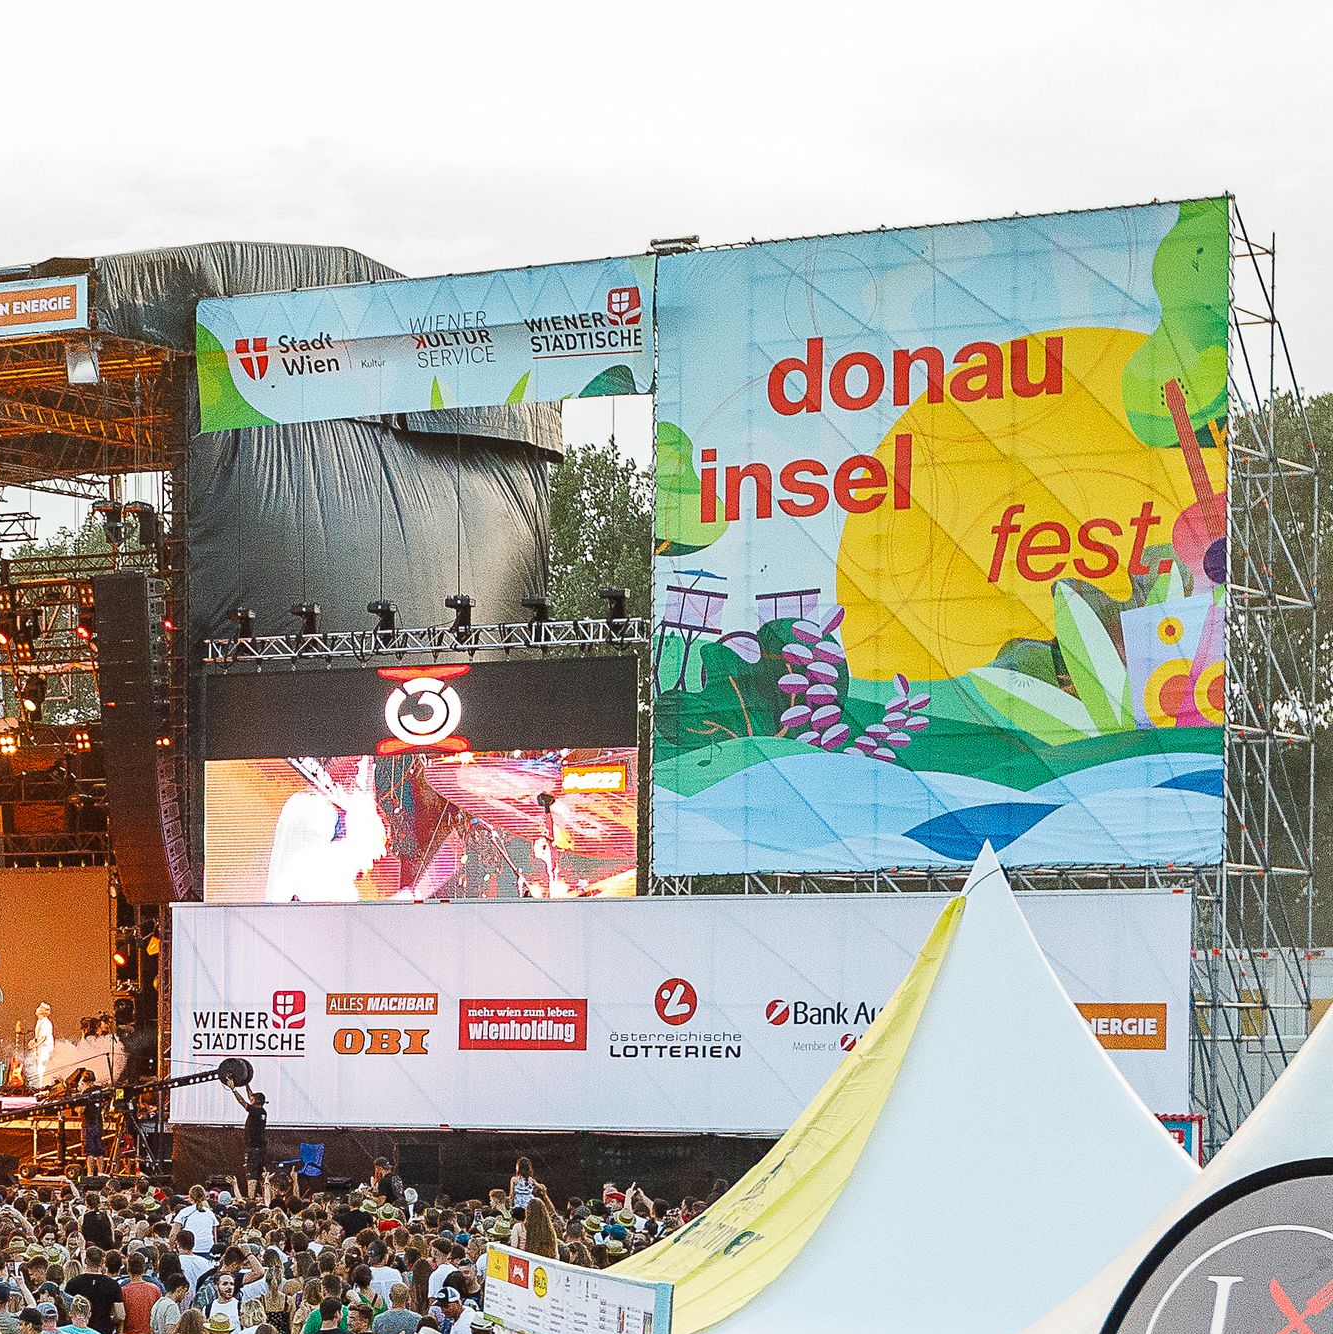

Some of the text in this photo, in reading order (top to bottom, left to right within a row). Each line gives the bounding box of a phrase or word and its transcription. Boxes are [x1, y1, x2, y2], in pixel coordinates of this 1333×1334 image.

[13, 295, 72, 316] ENERGIE
[409, 311, 487, 334] WIENER
[524, 311, 608, 334] WIENER
[279, 331, 334, 354] Stadt
[530, 327, 643, 353] STÄDTISCHE
[281, 355, 340, 376] Wien
[361, 358, 386, 370] Kultur
[417, 346, 496, 369] SERVICE
[768, 336, 1064, 415] donau
[699, 433, 913, 523] insel
[987, 500, 1173, 583] fest.
[330, 997, 434, 1011] ALLES MACHBAR
[467, 1006, 577, 1017] mehr wien zum leben.
[794, 1001, 848, 1025] Bank
[193, 1011, 269, 1030] WIENER
[193, 1030, 305, 1051] STÄDTISCHE
[333, 1028, 430, 1055] OBI
[610, 1030, 742, 1043] österreichische
[793, 1041, 838, 1051] Member of
[610, 1045, 742, 1059] LOTTERIEN
